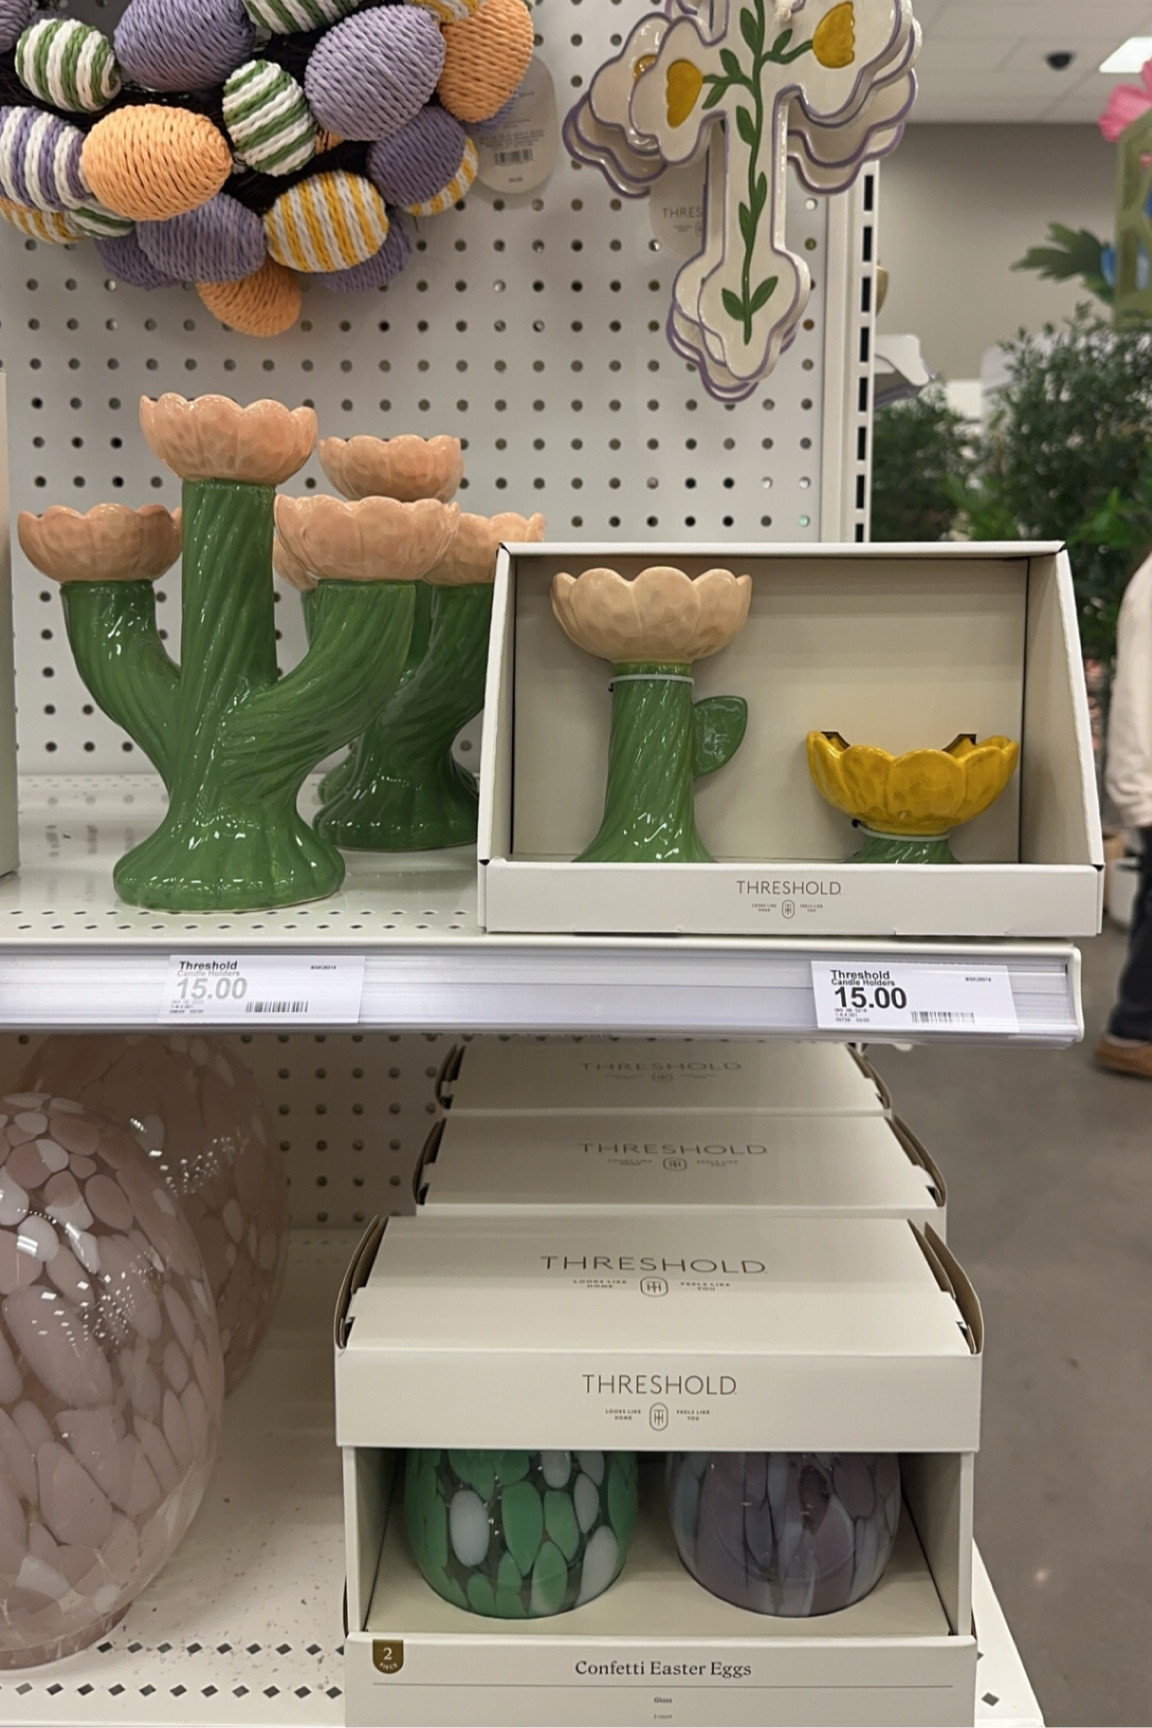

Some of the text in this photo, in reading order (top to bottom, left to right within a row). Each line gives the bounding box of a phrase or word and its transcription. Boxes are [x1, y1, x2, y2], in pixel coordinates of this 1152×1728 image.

[663, 207, 702, 218] THRES
[736, 880, 842, 895] THRESHOLD
[179, 960, 238, 970] Threshold
[830, 969, 890, 980] Threshold
[177, 977, 248, 1000] 15.00
[831, 978, 896, 987] Candle Holders
[834, 986, 908, 1009] 15.00
[580, 1062, 742, 1071] THRESHOLD
[579, 1143, 768, 1155] THRESHOLD
[540, 1256, 767, 1274] THRESHOLD
[582, 1374, 737, 1395] THRESHOLD
[383, 1647, 393, 1660] 2
[575, 1660, 752, 1679] Confetti Easter Eggs
